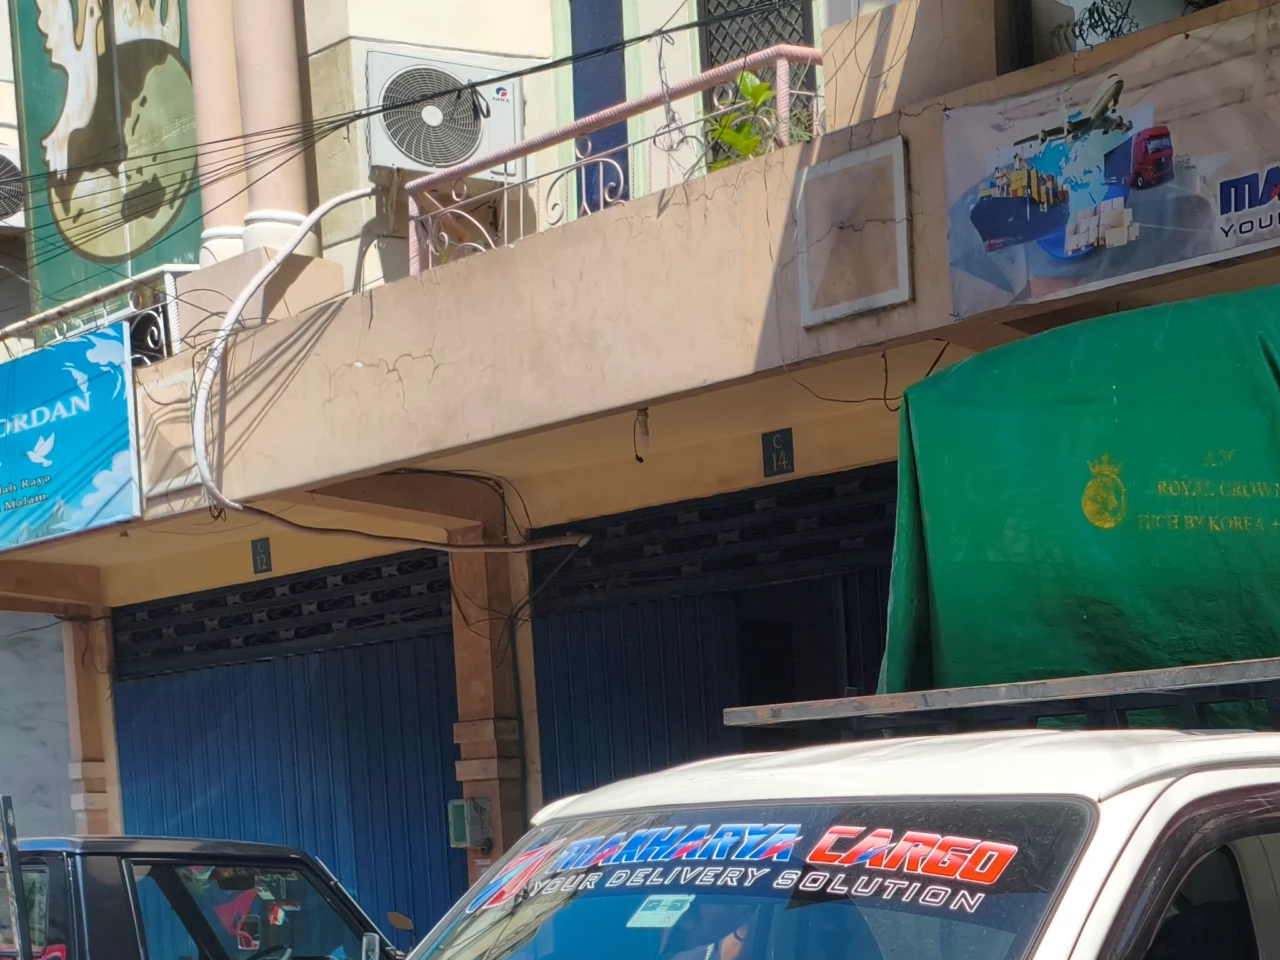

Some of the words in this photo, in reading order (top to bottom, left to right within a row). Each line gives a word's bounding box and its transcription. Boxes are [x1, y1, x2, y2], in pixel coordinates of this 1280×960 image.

[773, 434, 782, 448] C
[772, 451, 788, 471] 14
[1157, 480, 1216, 498] ROYAL
[1183, 514, 1205, 531] BY
[1207, 514, 1266, 532] KOREA
[549, 823, 802, 873] MAKHARYA
[807, 825, 1020, 884] CARGO
[528, 871, 599, 897] YOUR
[605, 866, 771, 888] DELIVERY
[772, 869, 986, 914] SOLUTION
